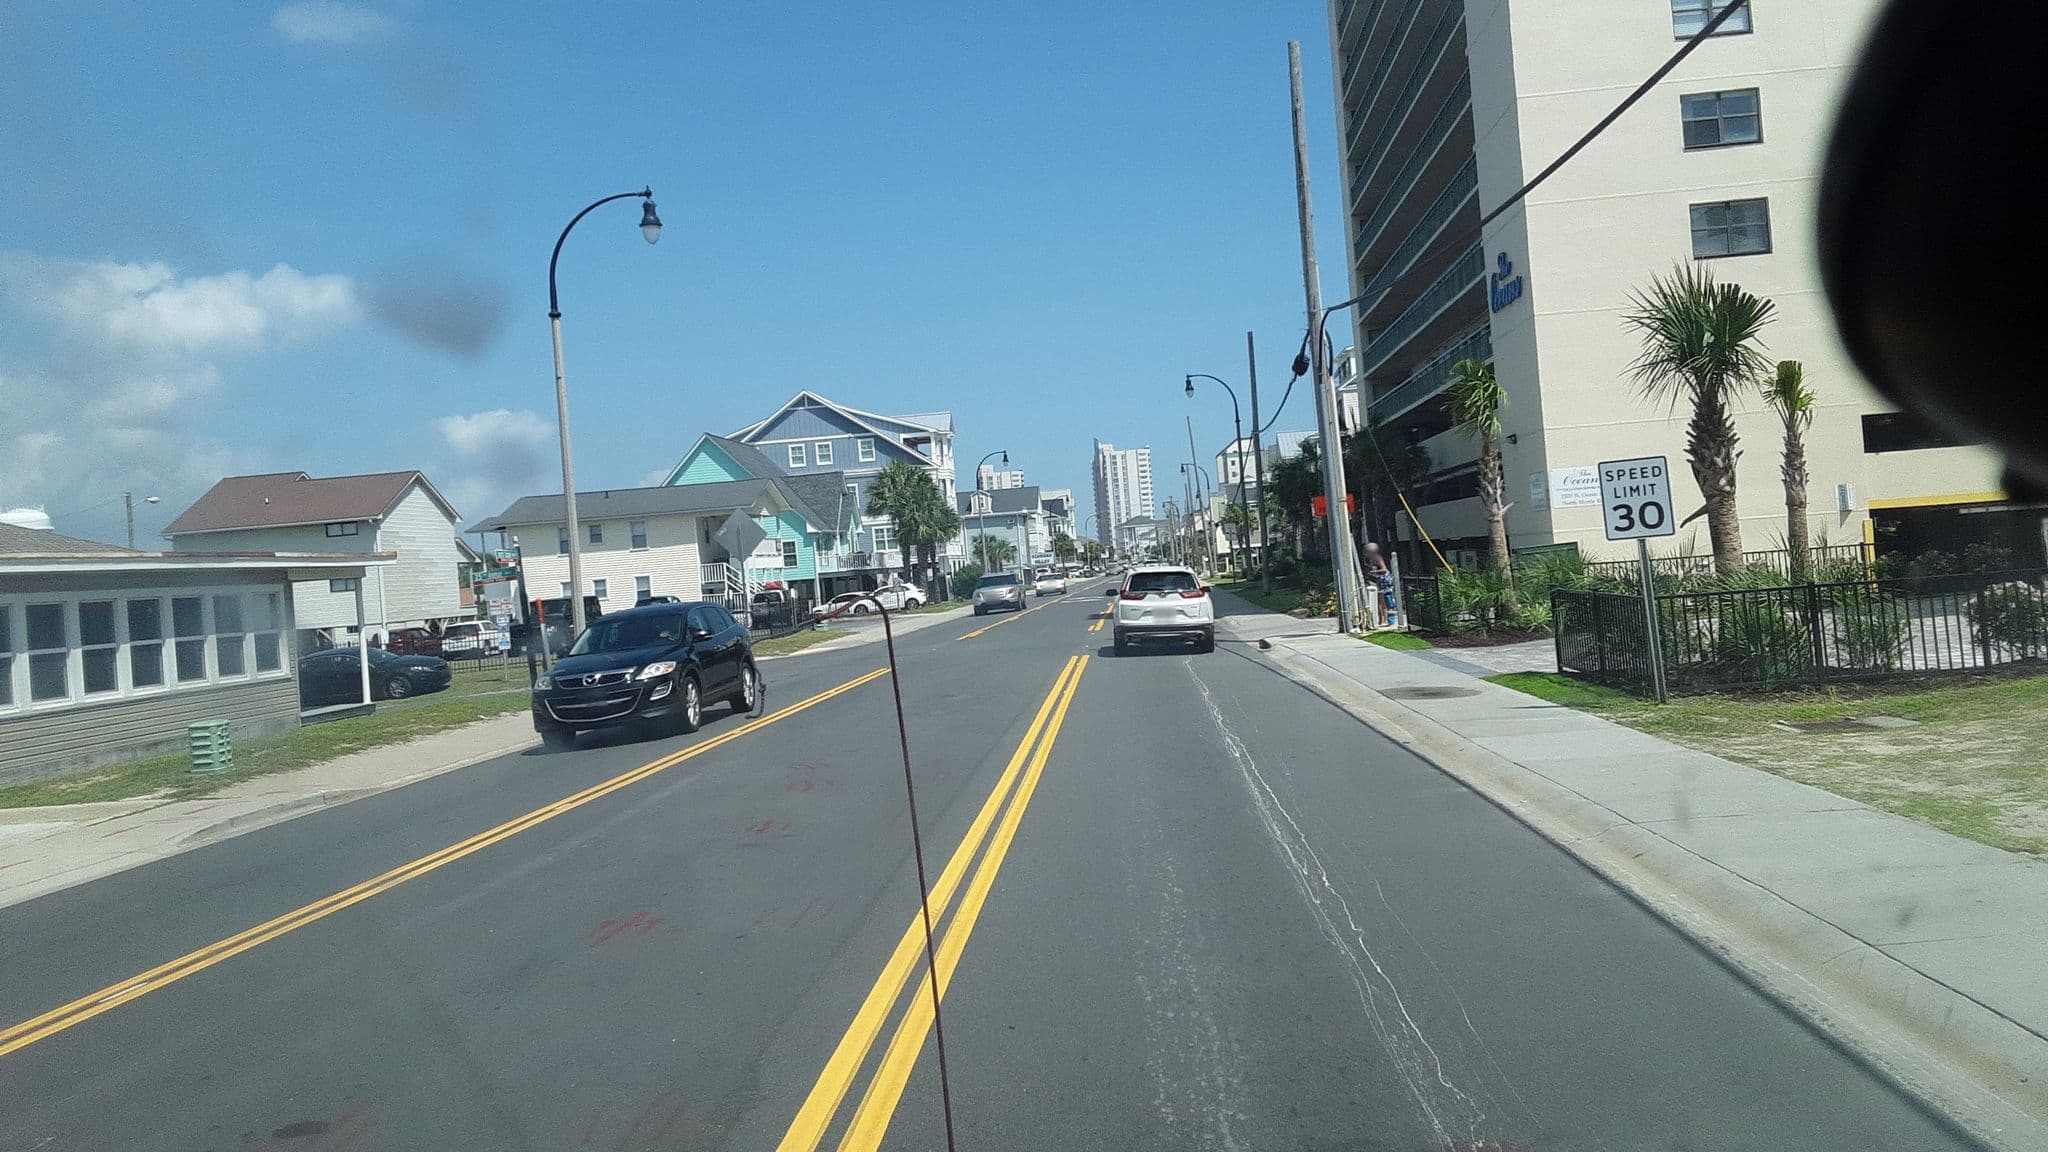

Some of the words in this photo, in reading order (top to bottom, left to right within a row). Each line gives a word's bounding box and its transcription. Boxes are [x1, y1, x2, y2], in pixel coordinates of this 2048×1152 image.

[1605, 466, 1662, 482] SPEED
[1613, 483, 1657, 499] LIMIT
[1611, 501, 1665, 532] 30
